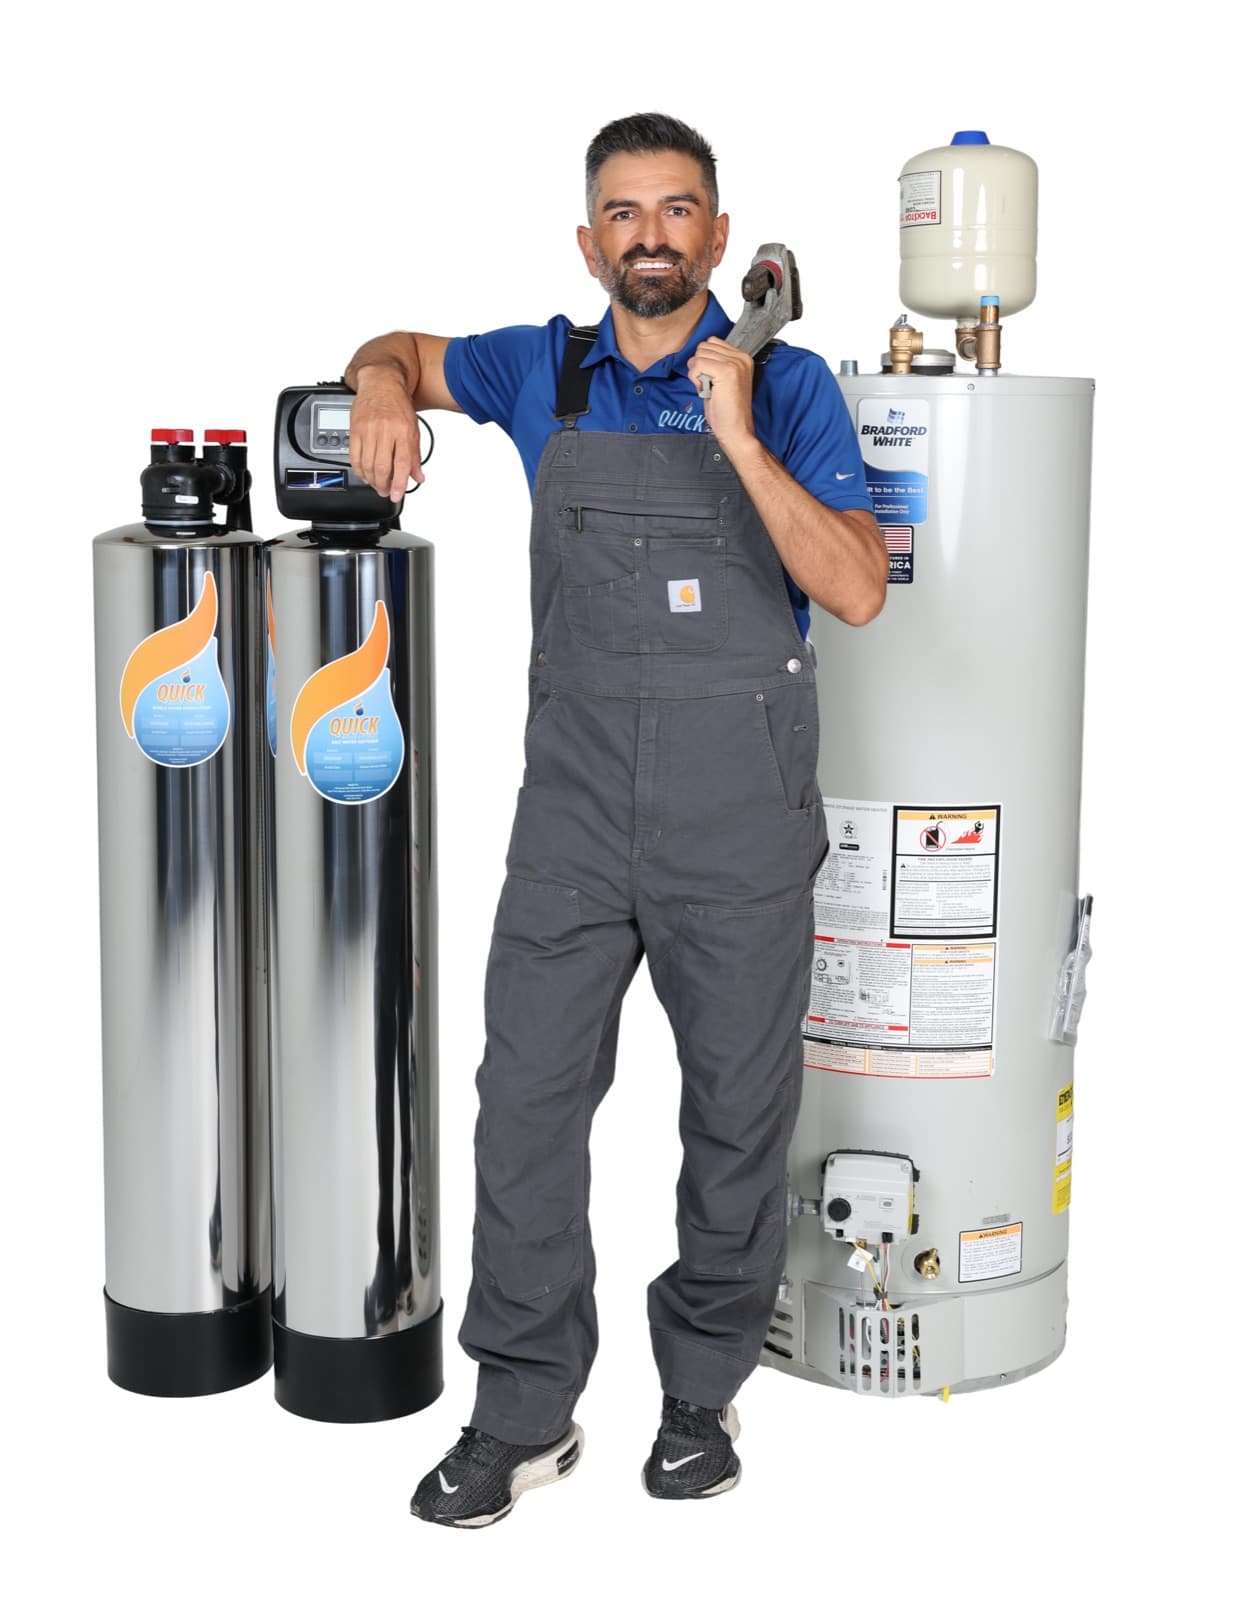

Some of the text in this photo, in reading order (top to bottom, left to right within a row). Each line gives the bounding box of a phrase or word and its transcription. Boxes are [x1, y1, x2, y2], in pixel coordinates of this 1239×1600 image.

[658, 410, 706, 433] QUICK
[861, 425, 928, 436] BRADFORD
[873, 436, 912, 447] WHITE
[888, 561, 911, 569] RICA
[157, 683, 206, 704] QUICK
[329, 716, 379, 737] QUICK
